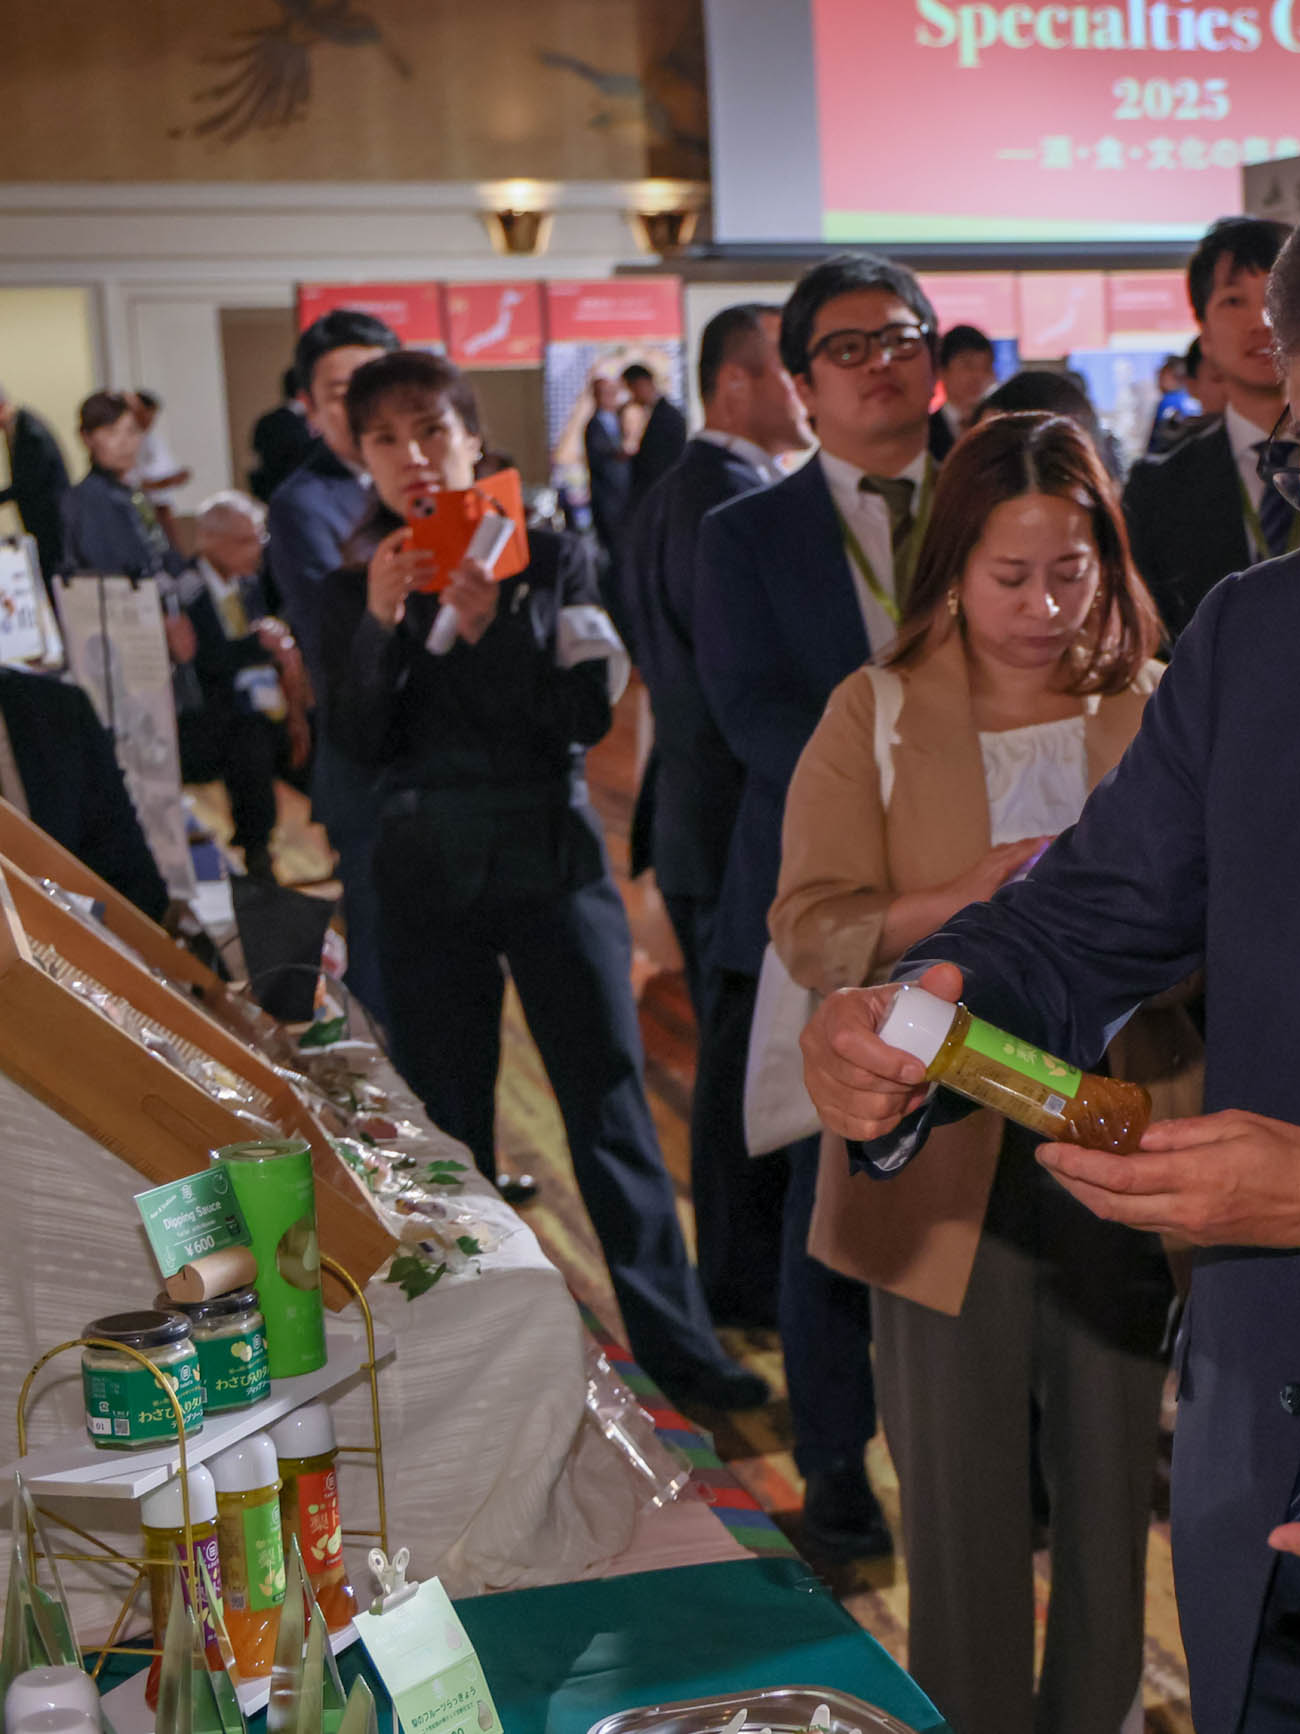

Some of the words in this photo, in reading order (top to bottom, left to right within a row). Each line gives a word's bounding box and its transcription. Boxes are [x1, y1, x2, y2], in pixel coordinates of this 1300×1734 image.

[915, 0, 1262, 67] Specialties
[1112, 76, 1231, 120] 2025
[163, 1210, 196, 1231] Dipping
[197, 1201, 222, 1218] Sauce
[184, 1235, 216, 1257] ¥600
